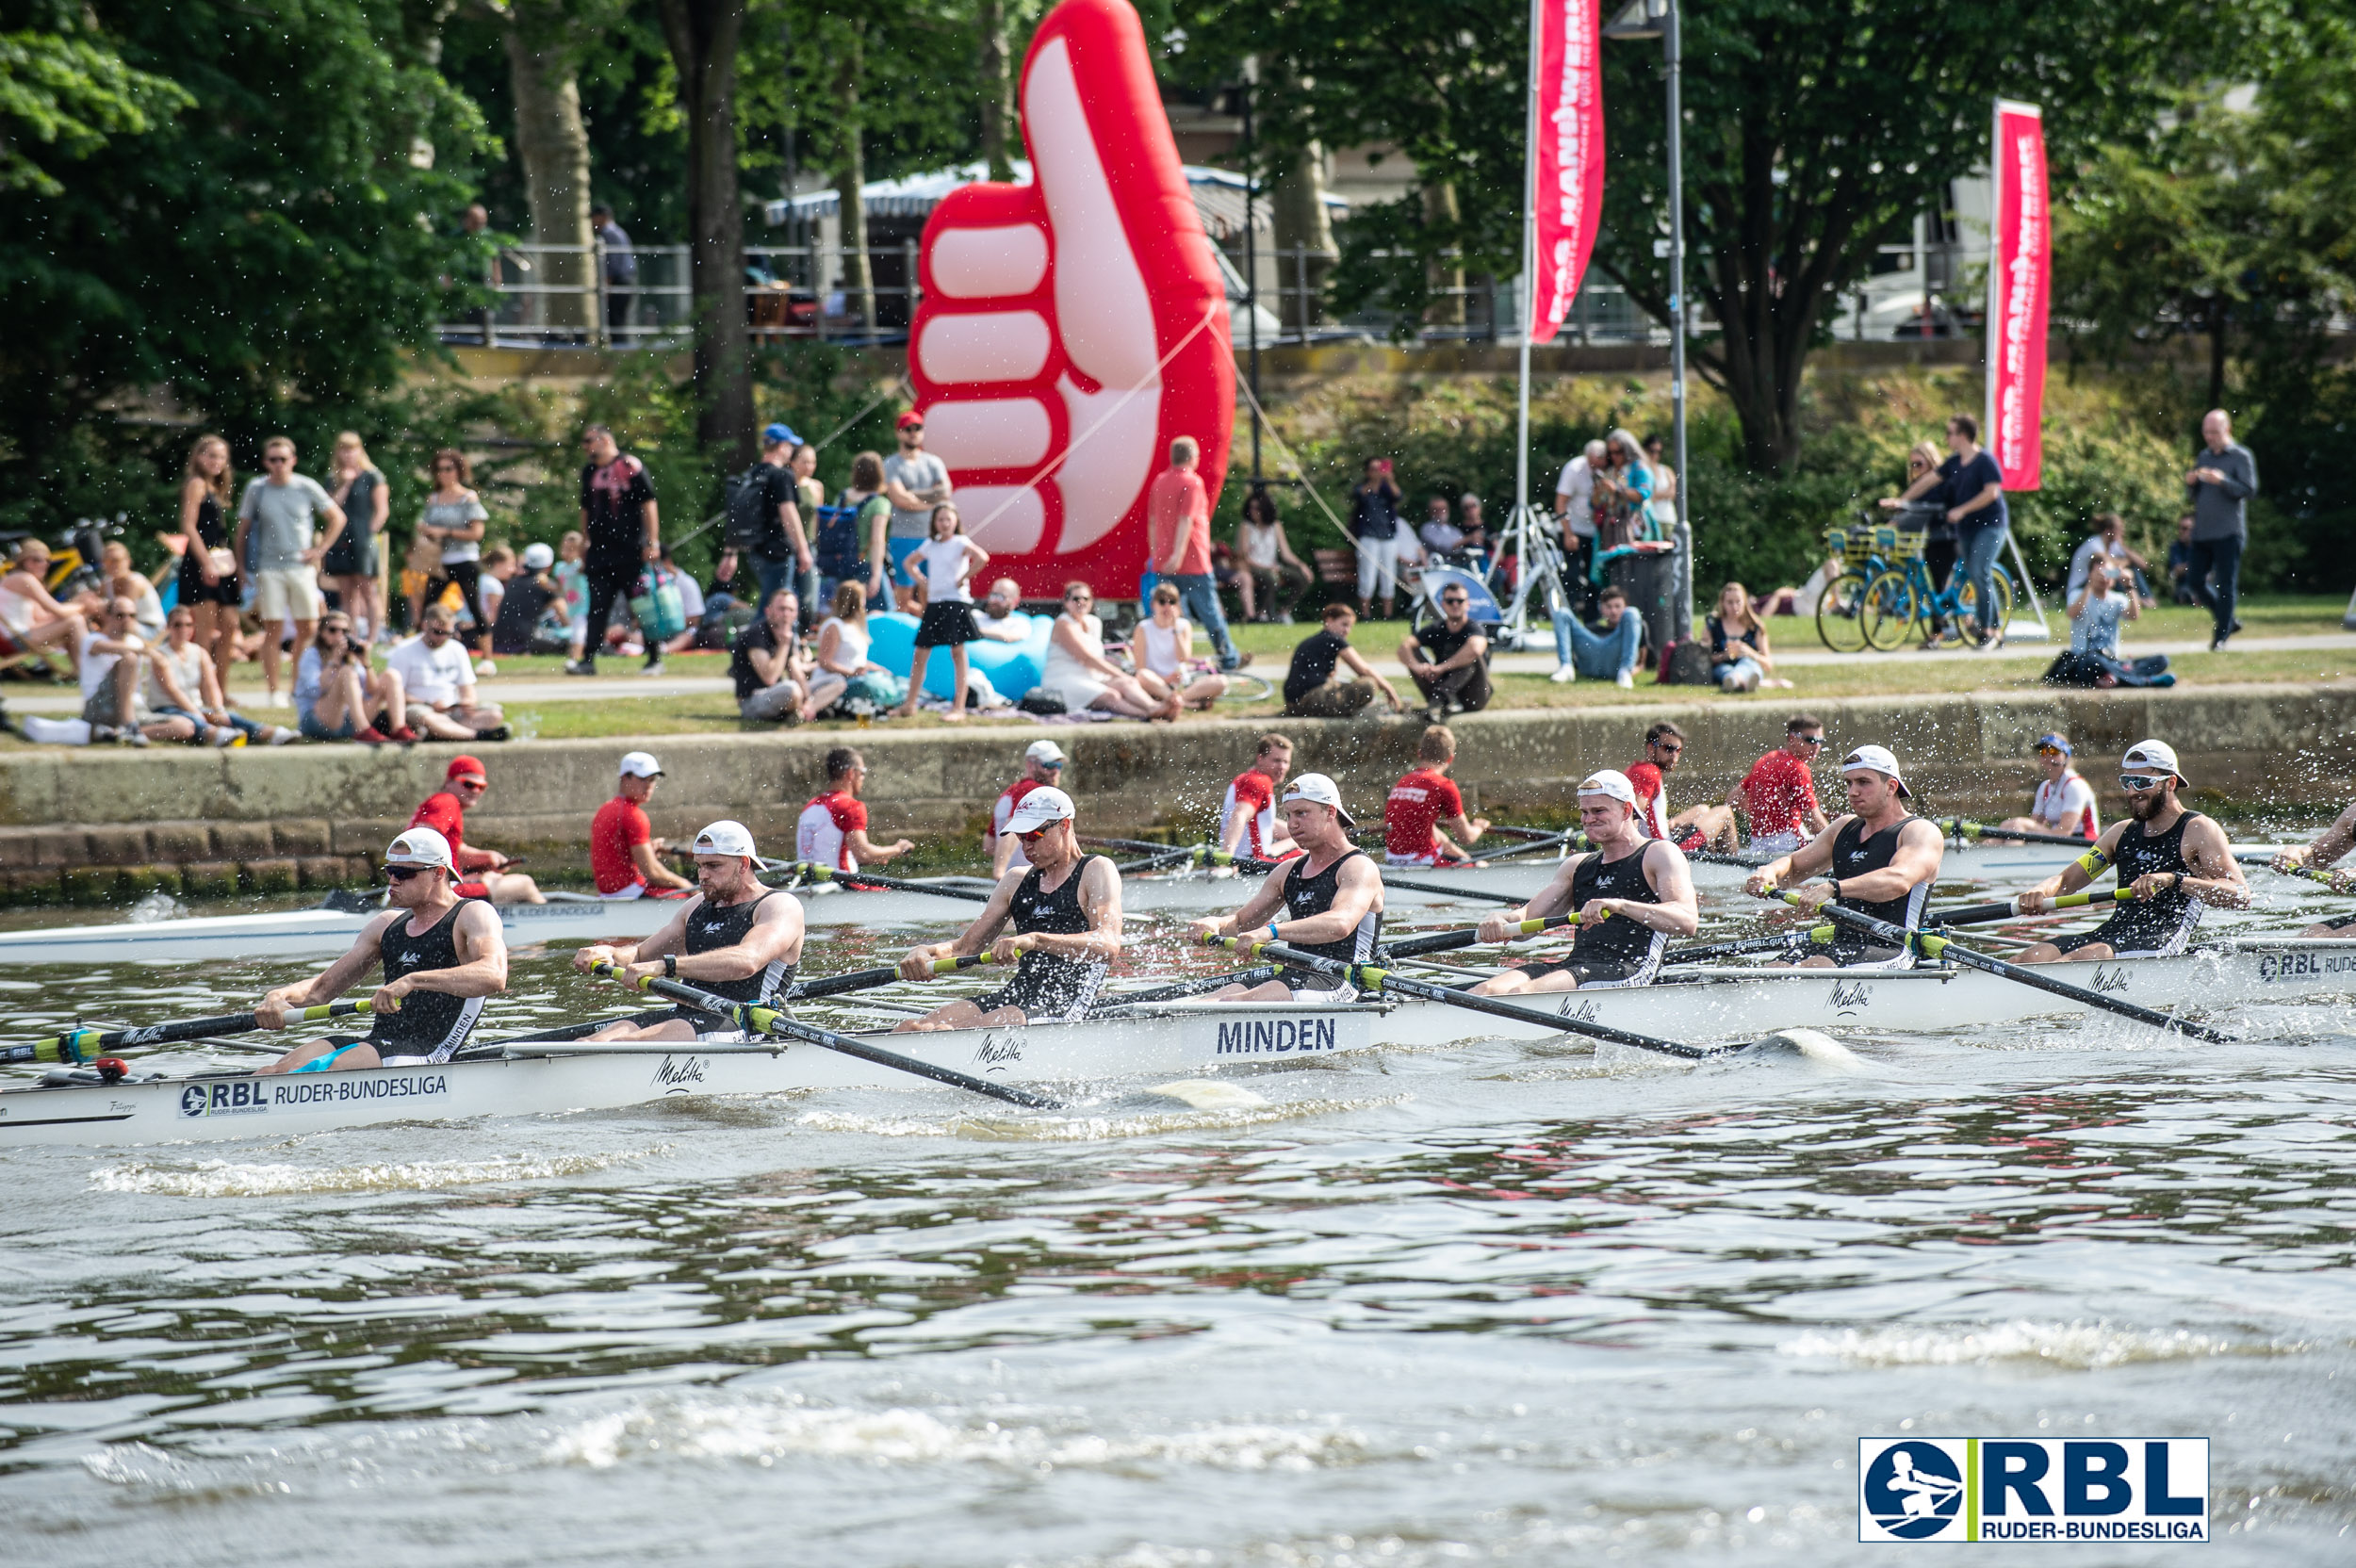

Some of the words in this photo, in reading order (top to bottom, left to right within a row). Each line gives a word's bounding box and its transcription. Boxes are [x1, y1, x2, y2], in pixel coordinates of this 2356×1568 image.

[1253, 968, 1272, 978] RBL
[2280, 953, 2320, 975] RBL
[2087, 964, 2129, 992] Melitta
[1432, 989, 1446, 1000] RBL
[1824, 979, 1870, 1009] Melitta
[445, 1013, 471, 1051] MINDEN
[595, 1021, 616, 1033] STA
[1217, 1019, 1335, 1054] MINDEN
[13, 1046, 34, 1056] RBL
[822, 1035, 836, 1046] RBL
[972, 1033, 1023, 1065] Melitta
[650, 1054, 705, 1086] Melitta
[210, 1082, 268, 1108] RBL
[275, 1075, 447, 1104] RUDER-BUNDESLIGA
[210, 1105, 268, 1116] RUDER-BUNDESLIGA
